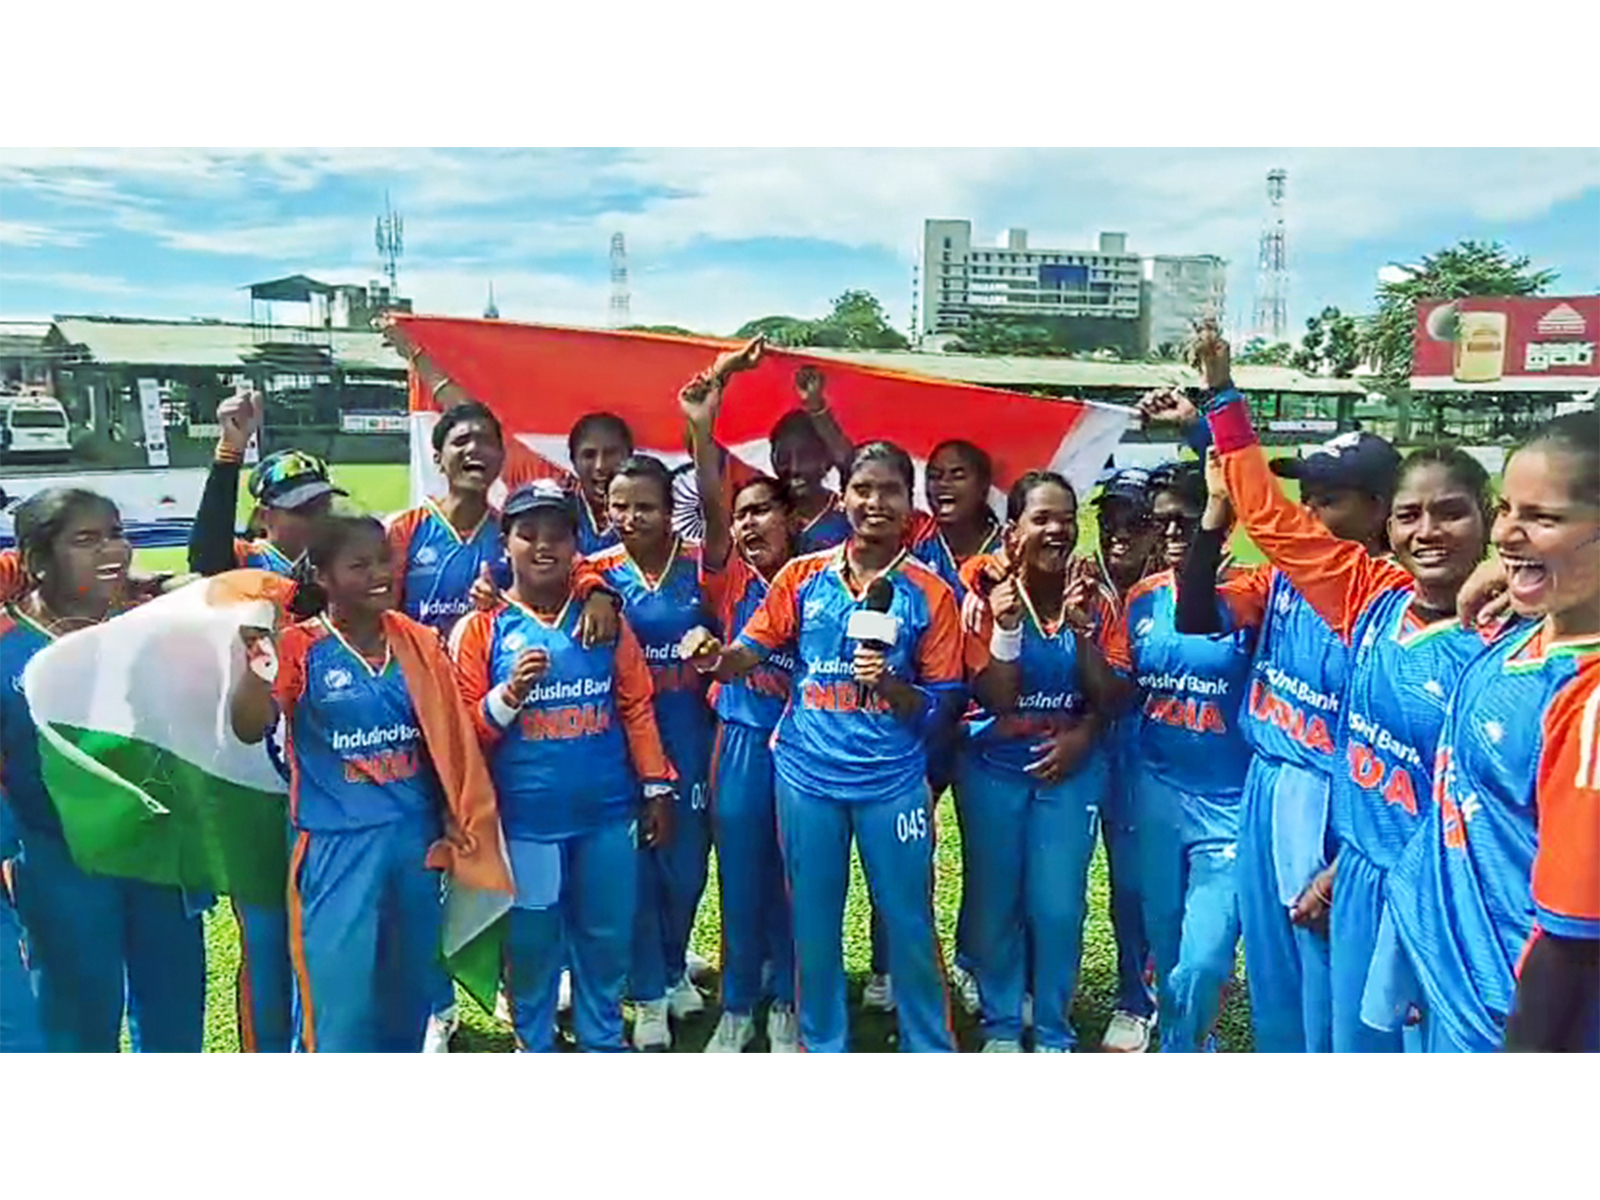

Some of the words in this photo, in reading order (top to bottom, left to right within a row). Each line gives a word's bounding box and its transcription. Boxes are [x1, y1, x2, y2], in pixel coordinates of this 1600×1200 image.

[525, 679, 582, 702] dusInd
[1186, 675, 1229, 695] Bank
[1297, 681, 1339, 712] Bank
[332, 725, 400, 750] IndusInd
[897, 807, 927, 843] 045
